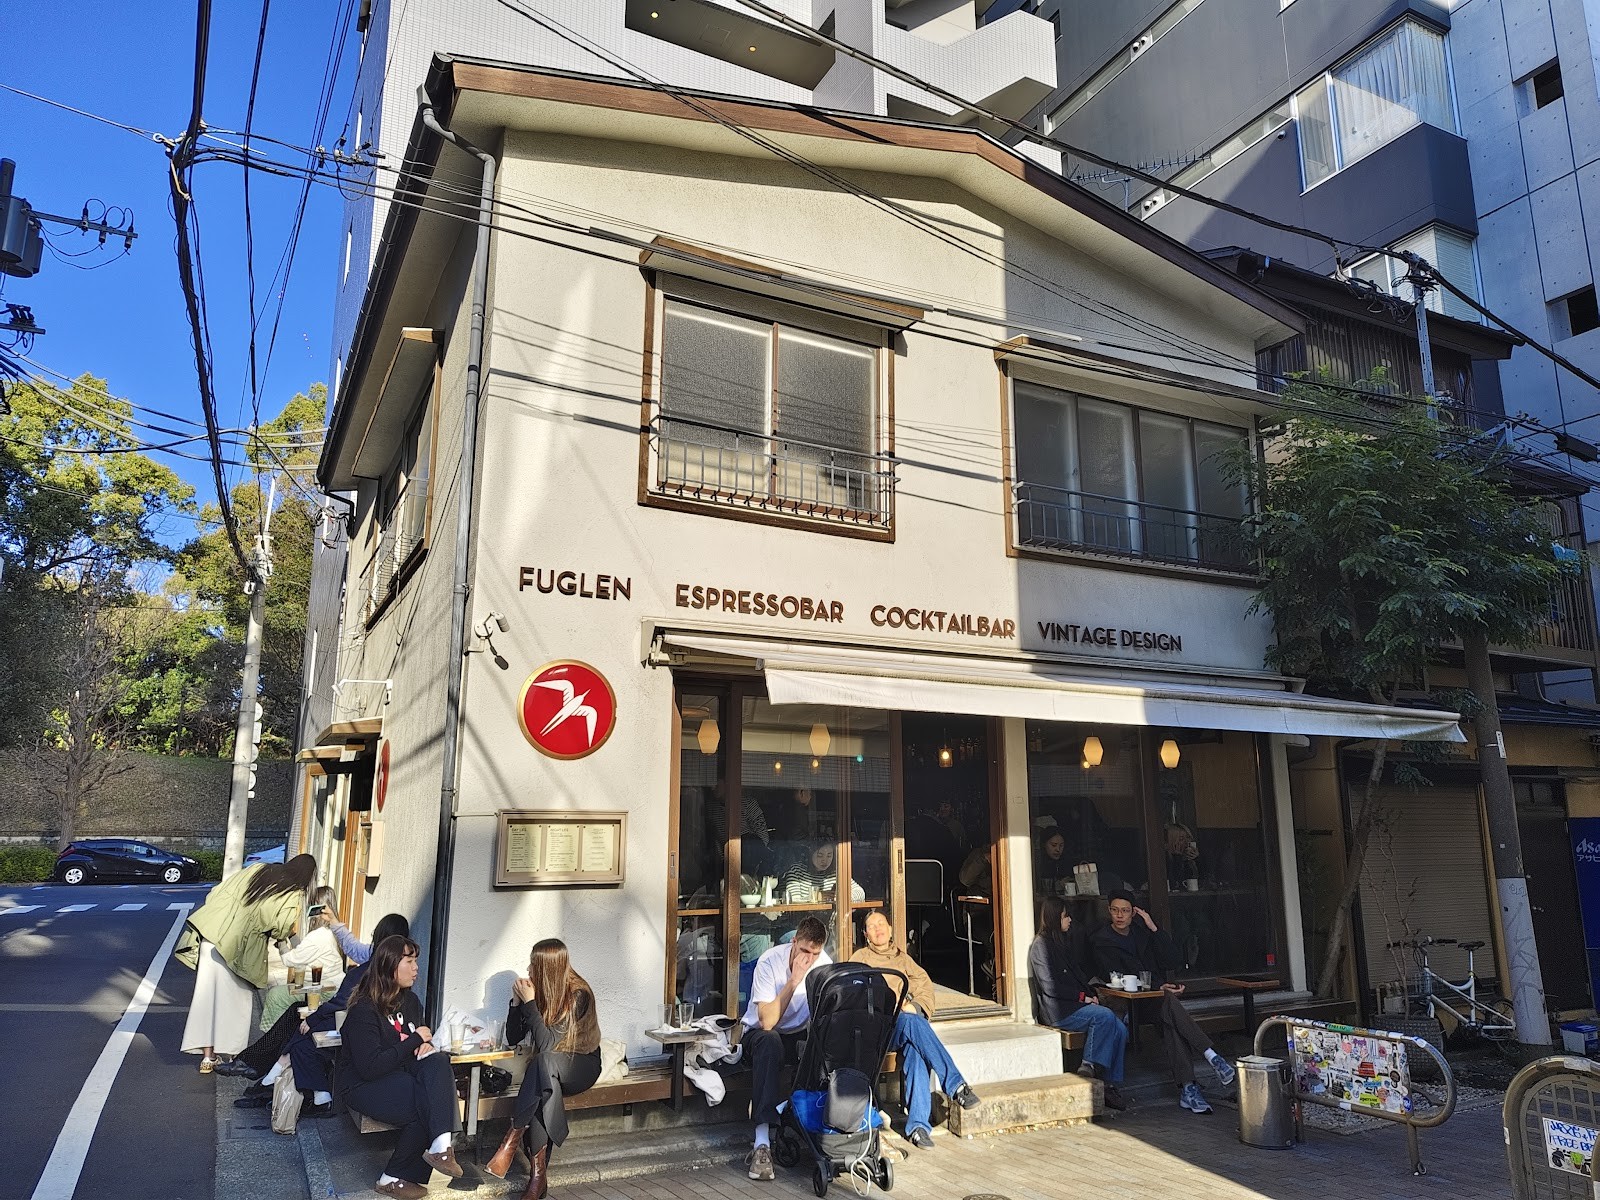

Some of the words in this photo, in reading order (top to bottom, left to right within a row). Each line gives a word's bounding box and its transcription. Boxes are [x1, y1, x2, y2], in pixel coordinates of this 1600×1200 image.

[519, 566, 632, 601] FUGLEN
[675, 584, 844, 623] ESPRESSOBAR
[870, 605, 1016, 640] COCKTAILBAR
[1037, 621, 1118, 647] VINTAGE
[1121, 630, 1183, 652] DESIGN
